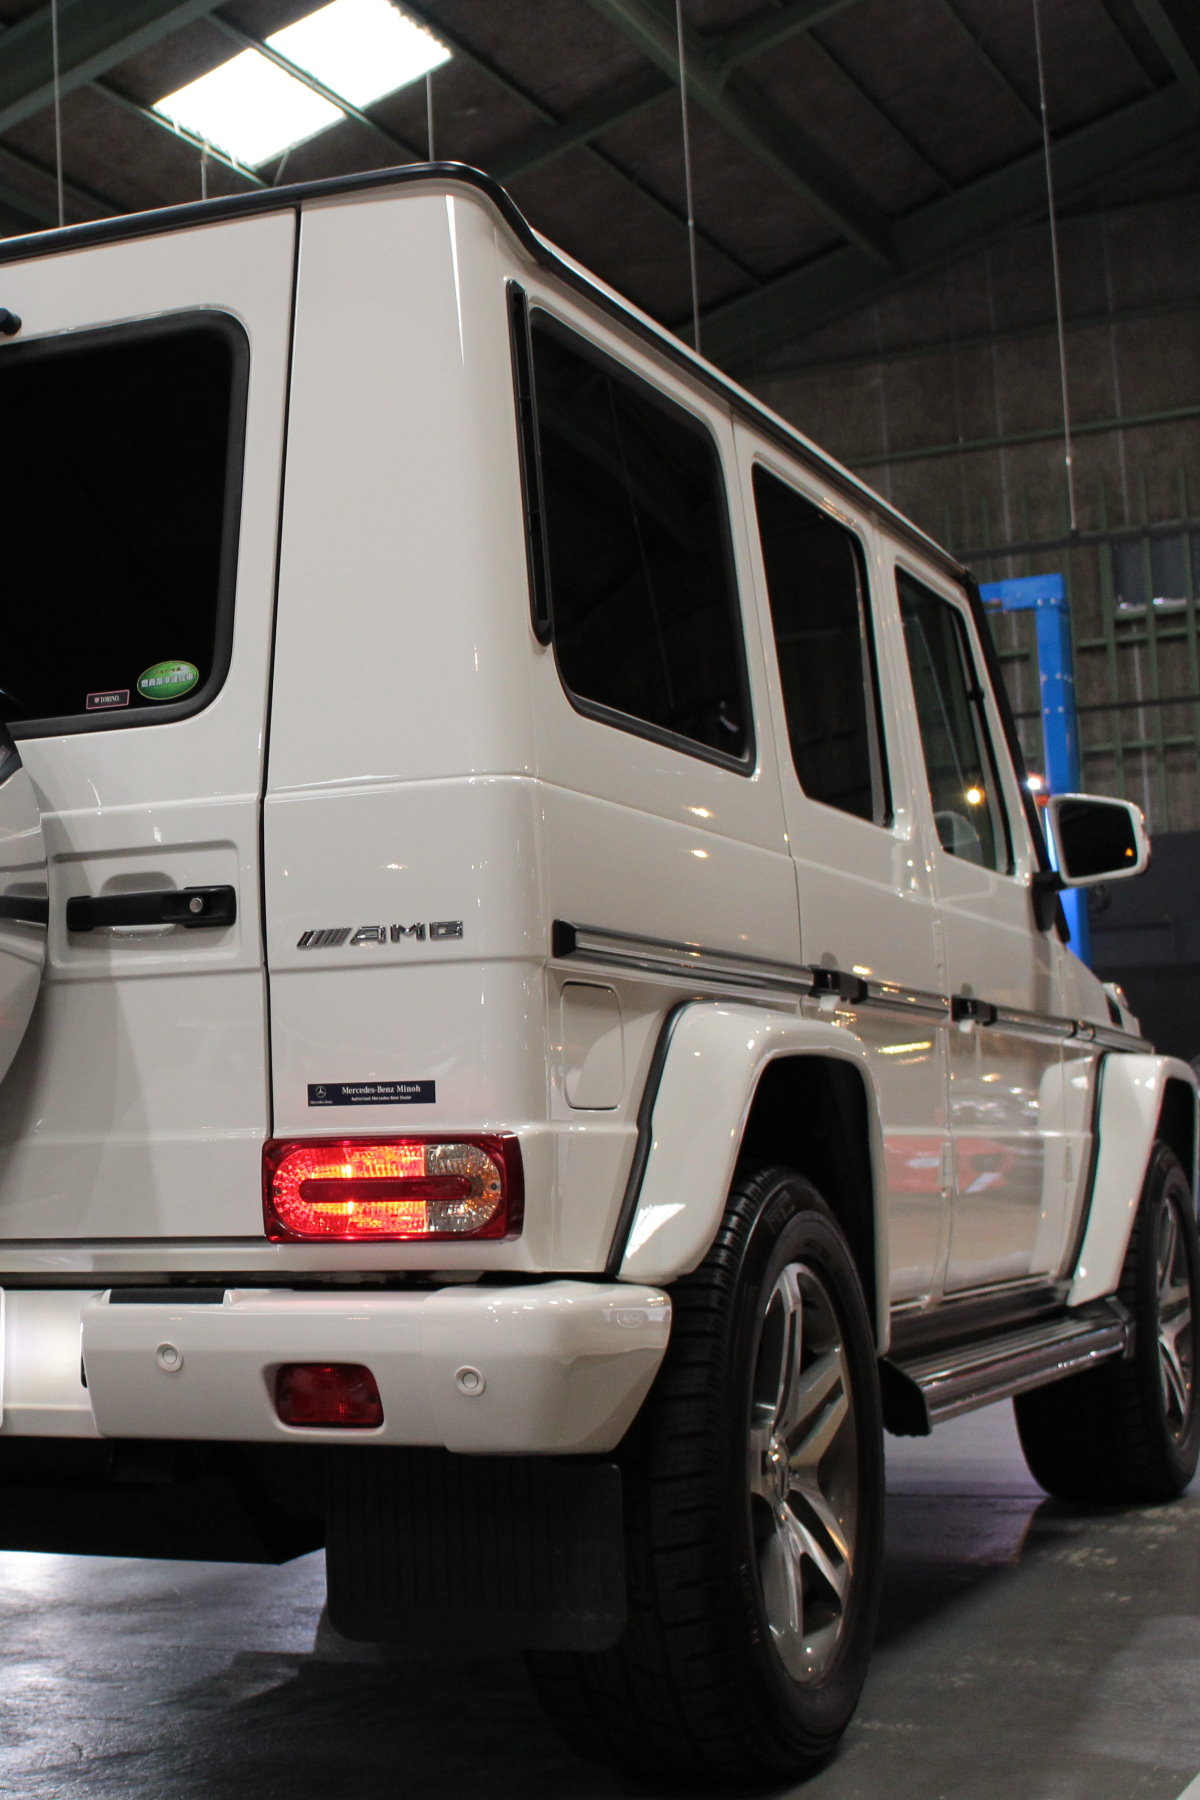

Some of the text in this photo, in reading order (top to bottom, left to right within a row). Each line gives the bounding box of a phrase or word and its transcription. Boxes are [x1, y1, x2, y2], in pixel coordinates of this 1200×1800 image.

[350, 921, 463, 945] AMG
[341, 1084, 421, 1095] Mercedes-Benz Minoh
